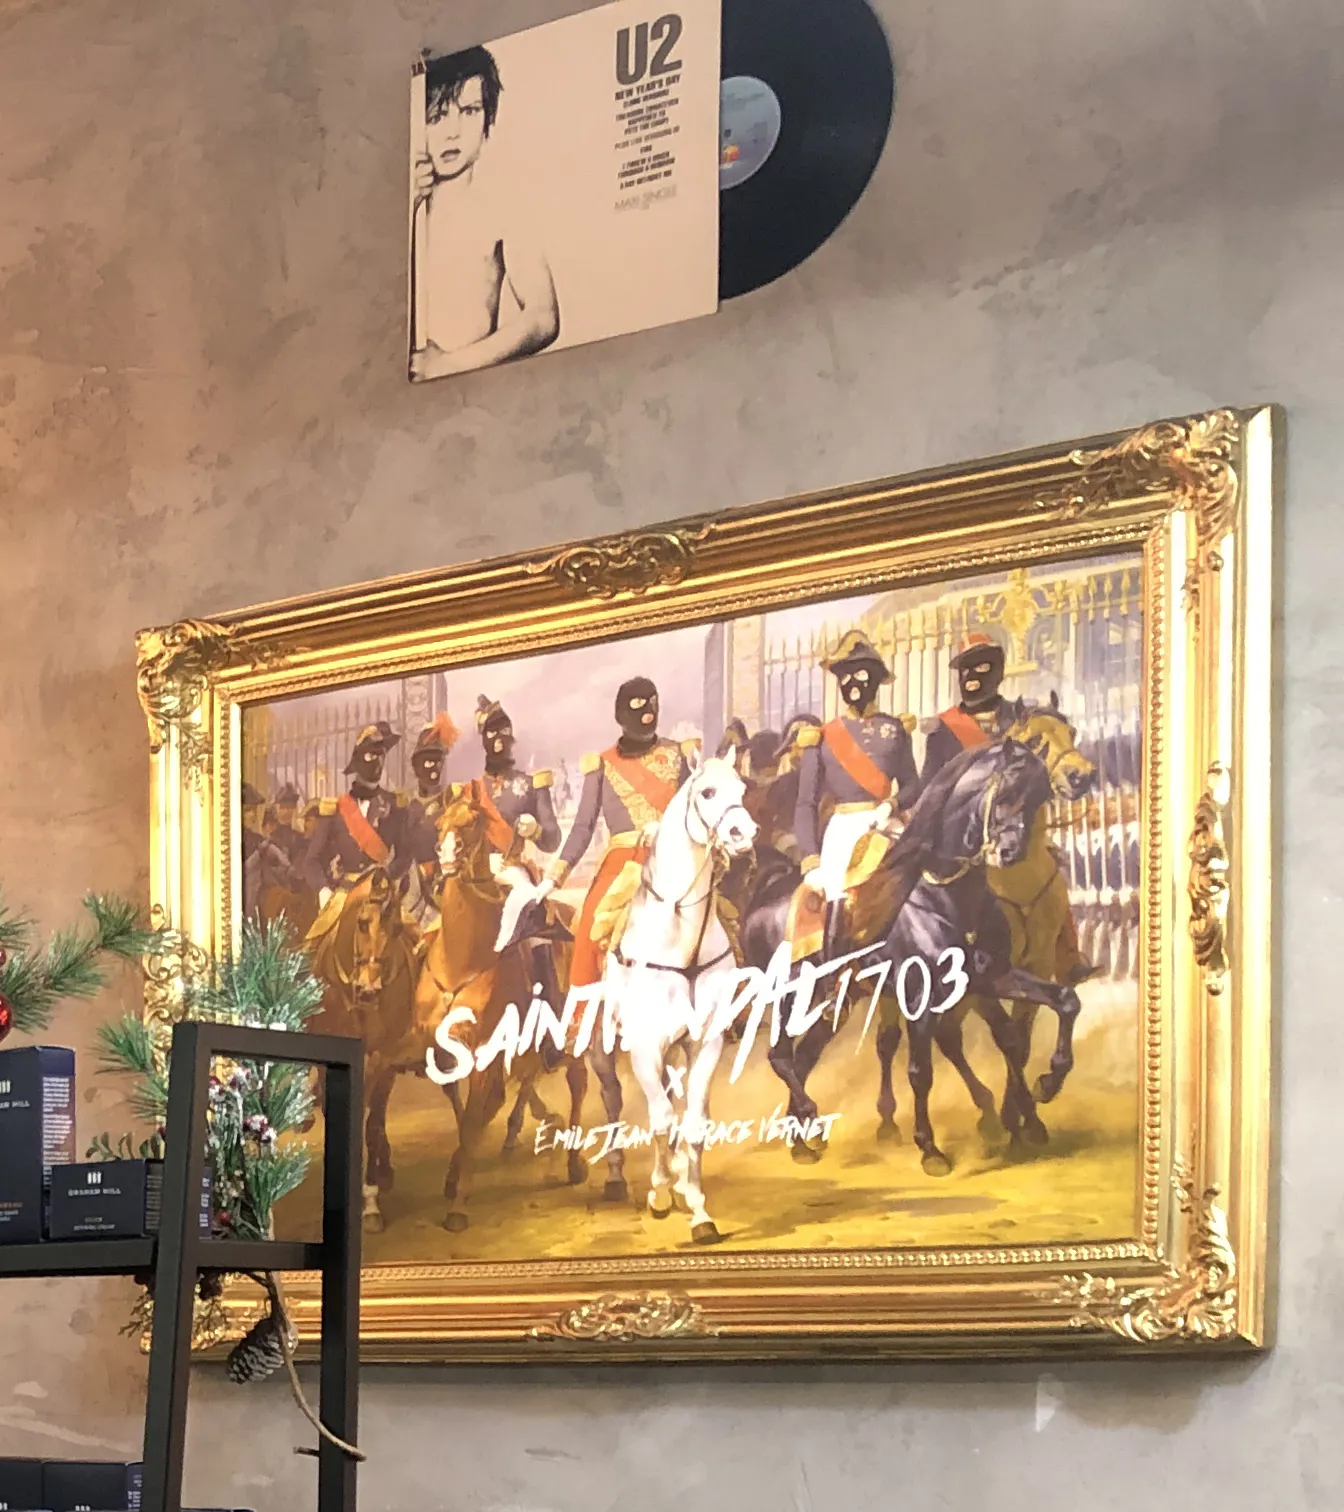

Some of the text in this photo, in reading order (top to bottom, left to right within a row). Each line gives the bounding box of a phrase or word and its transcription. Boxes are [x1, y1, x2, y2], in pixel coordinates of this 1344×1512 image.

[616, 13, 682, 85] U2
[669, 1110, 755, 1151] HRACE
[758, 1102, 843, 1148] VERNET
